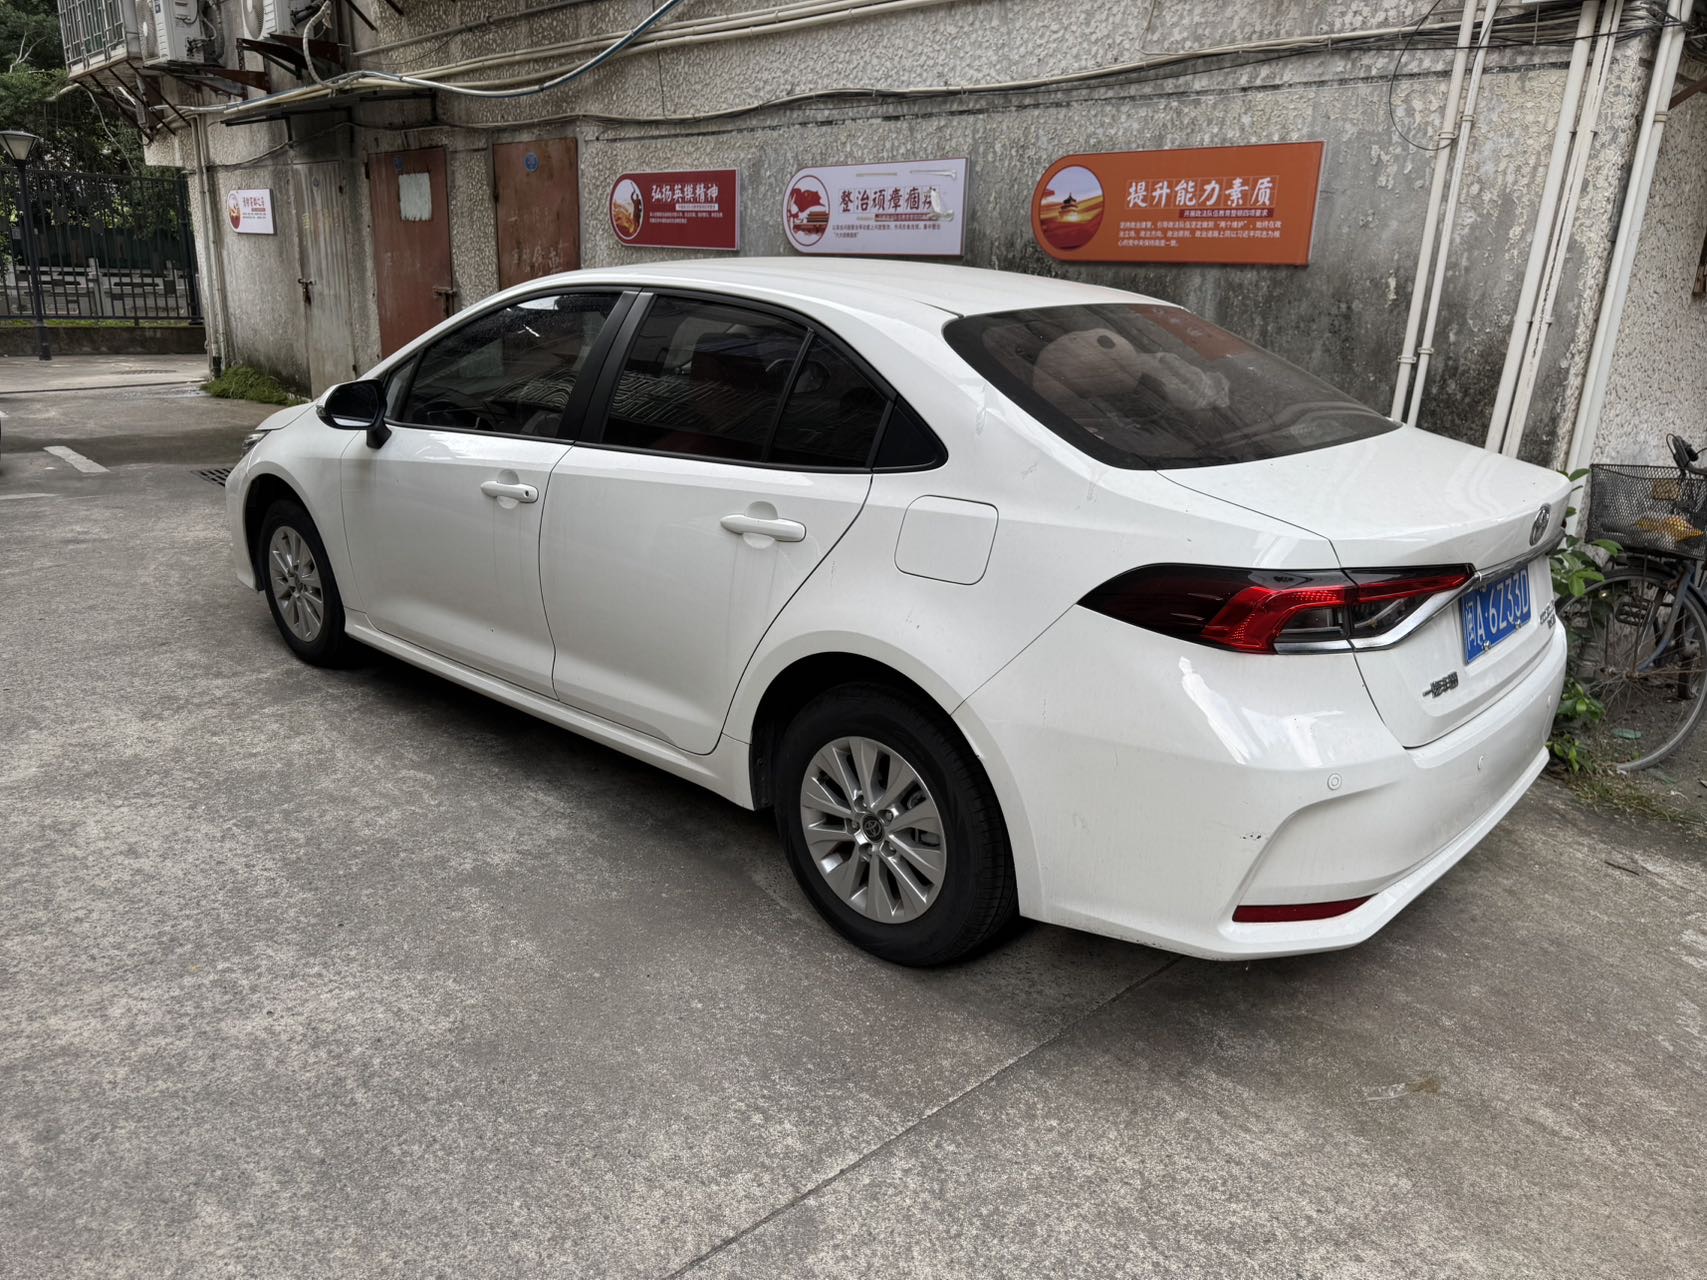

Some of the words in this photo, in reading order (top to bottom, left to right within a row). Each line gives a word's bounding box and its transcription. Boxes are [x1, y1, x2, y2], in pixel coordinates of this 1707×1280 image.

[651, 183, 719, 203] 弘扬英模精神
[1126, 177, 1273, 208] 提升能力素质
